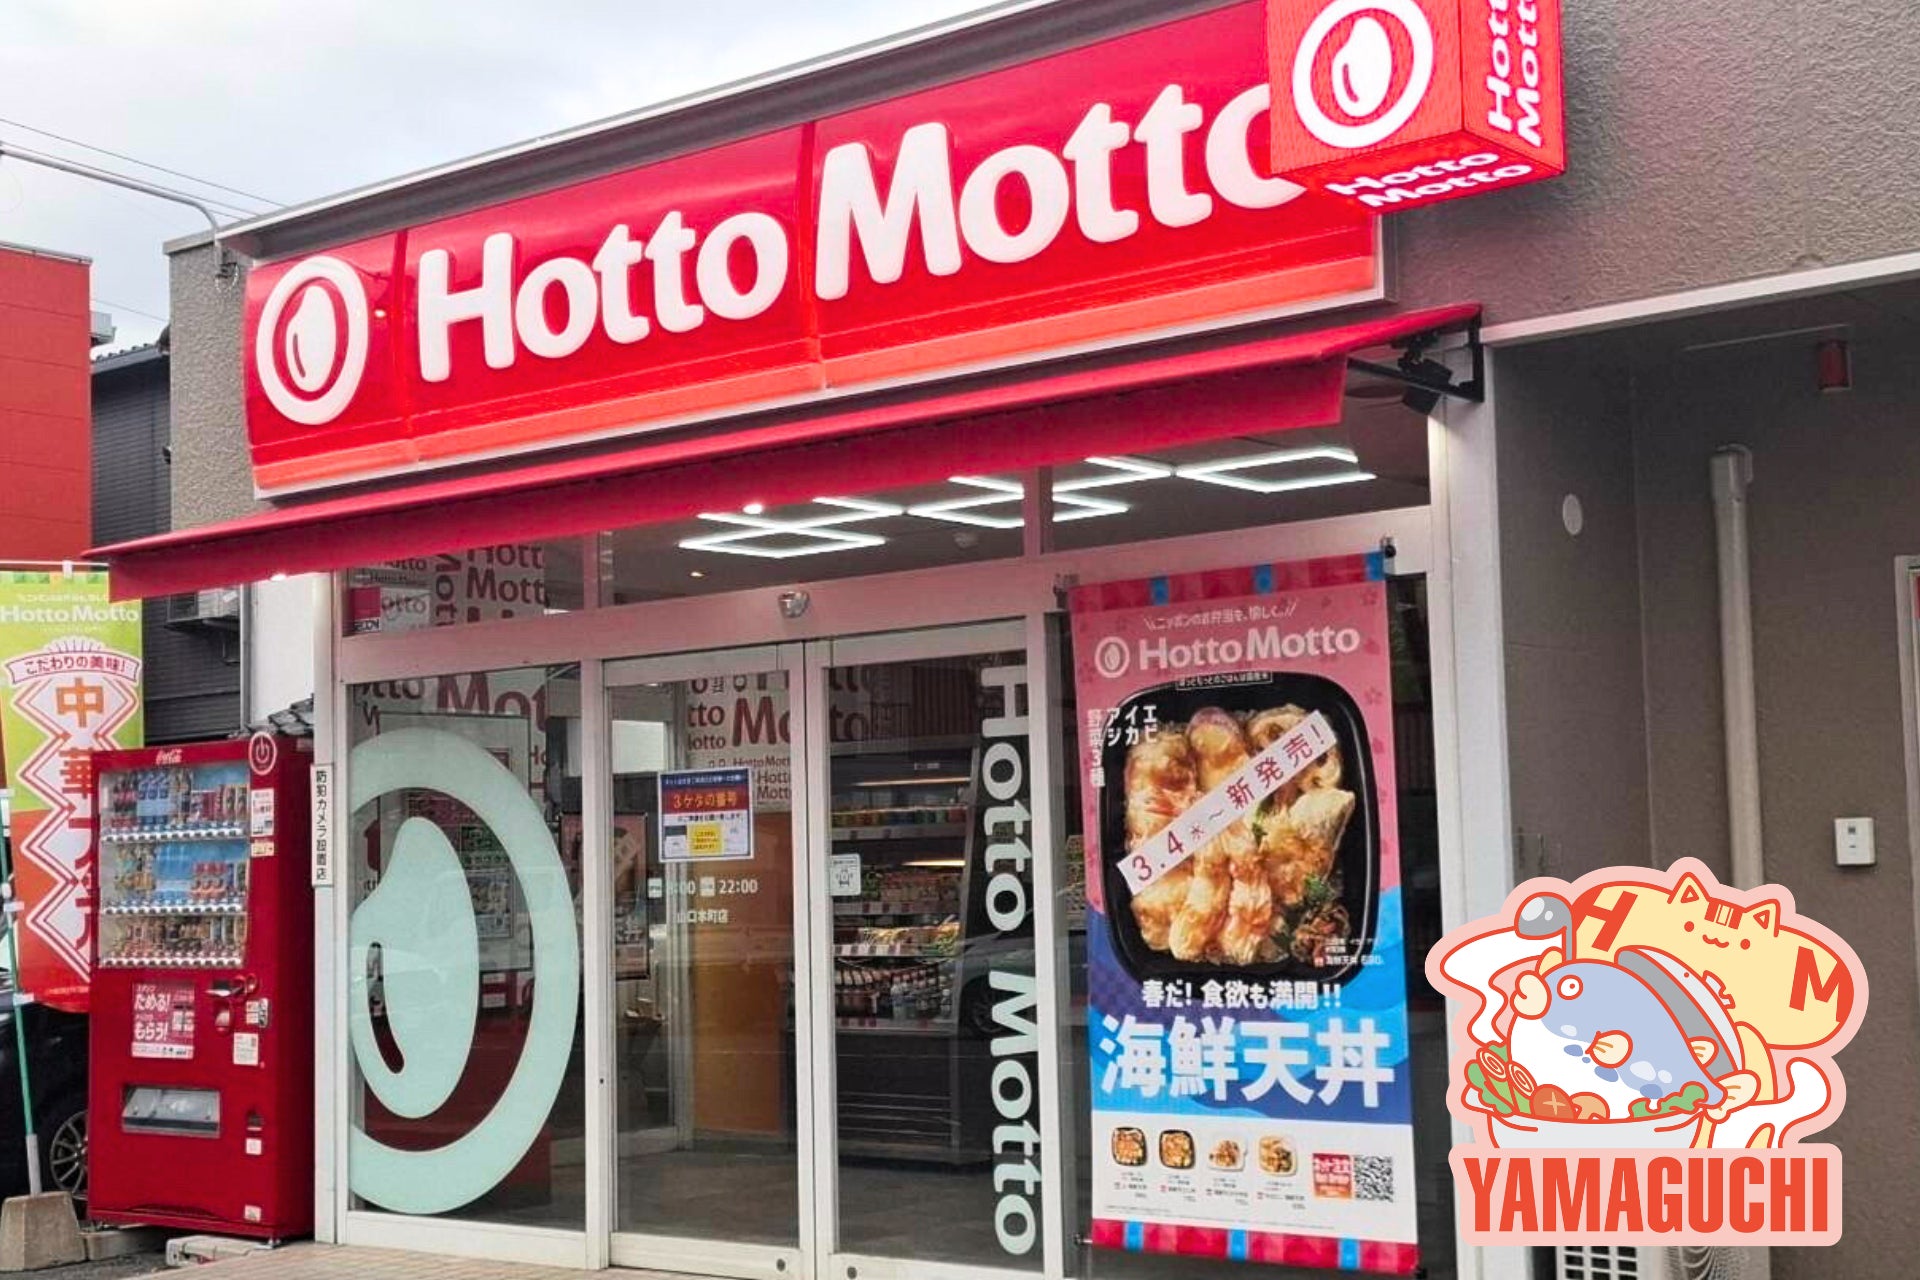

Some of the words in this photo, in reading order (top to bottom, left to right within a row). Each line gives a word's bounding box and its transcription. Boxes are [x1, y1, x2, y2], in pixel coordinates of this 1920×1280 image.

[1325, 153, 1499, 195] Hotto
[1358, 165, 1532, 207] Motto
[418, 211, 789, 382] Hotto
[815, 84, 1307, 300] Motto
[0, 605, 70, 622] Hotto
[72, 604, 140, 622] Motto
[1138, 636, 1243, 671] Hotto
[1246, 625, 1361, 662] Motto
[1107, 706, 1122, 747] アジ
[1124, 705, 1140, 746] イカ
[1144, 705, 1158, 744] エビ
[981, 665, 1032, 932] Hotto
[315, 770, 328, 881] 防犯カメラ設置店
[719, 878, 758, 894] 22:00
[1099, 1013, 1395, 1108] 海鮮天丼
[988, 969, 1043, 1256] Motto
